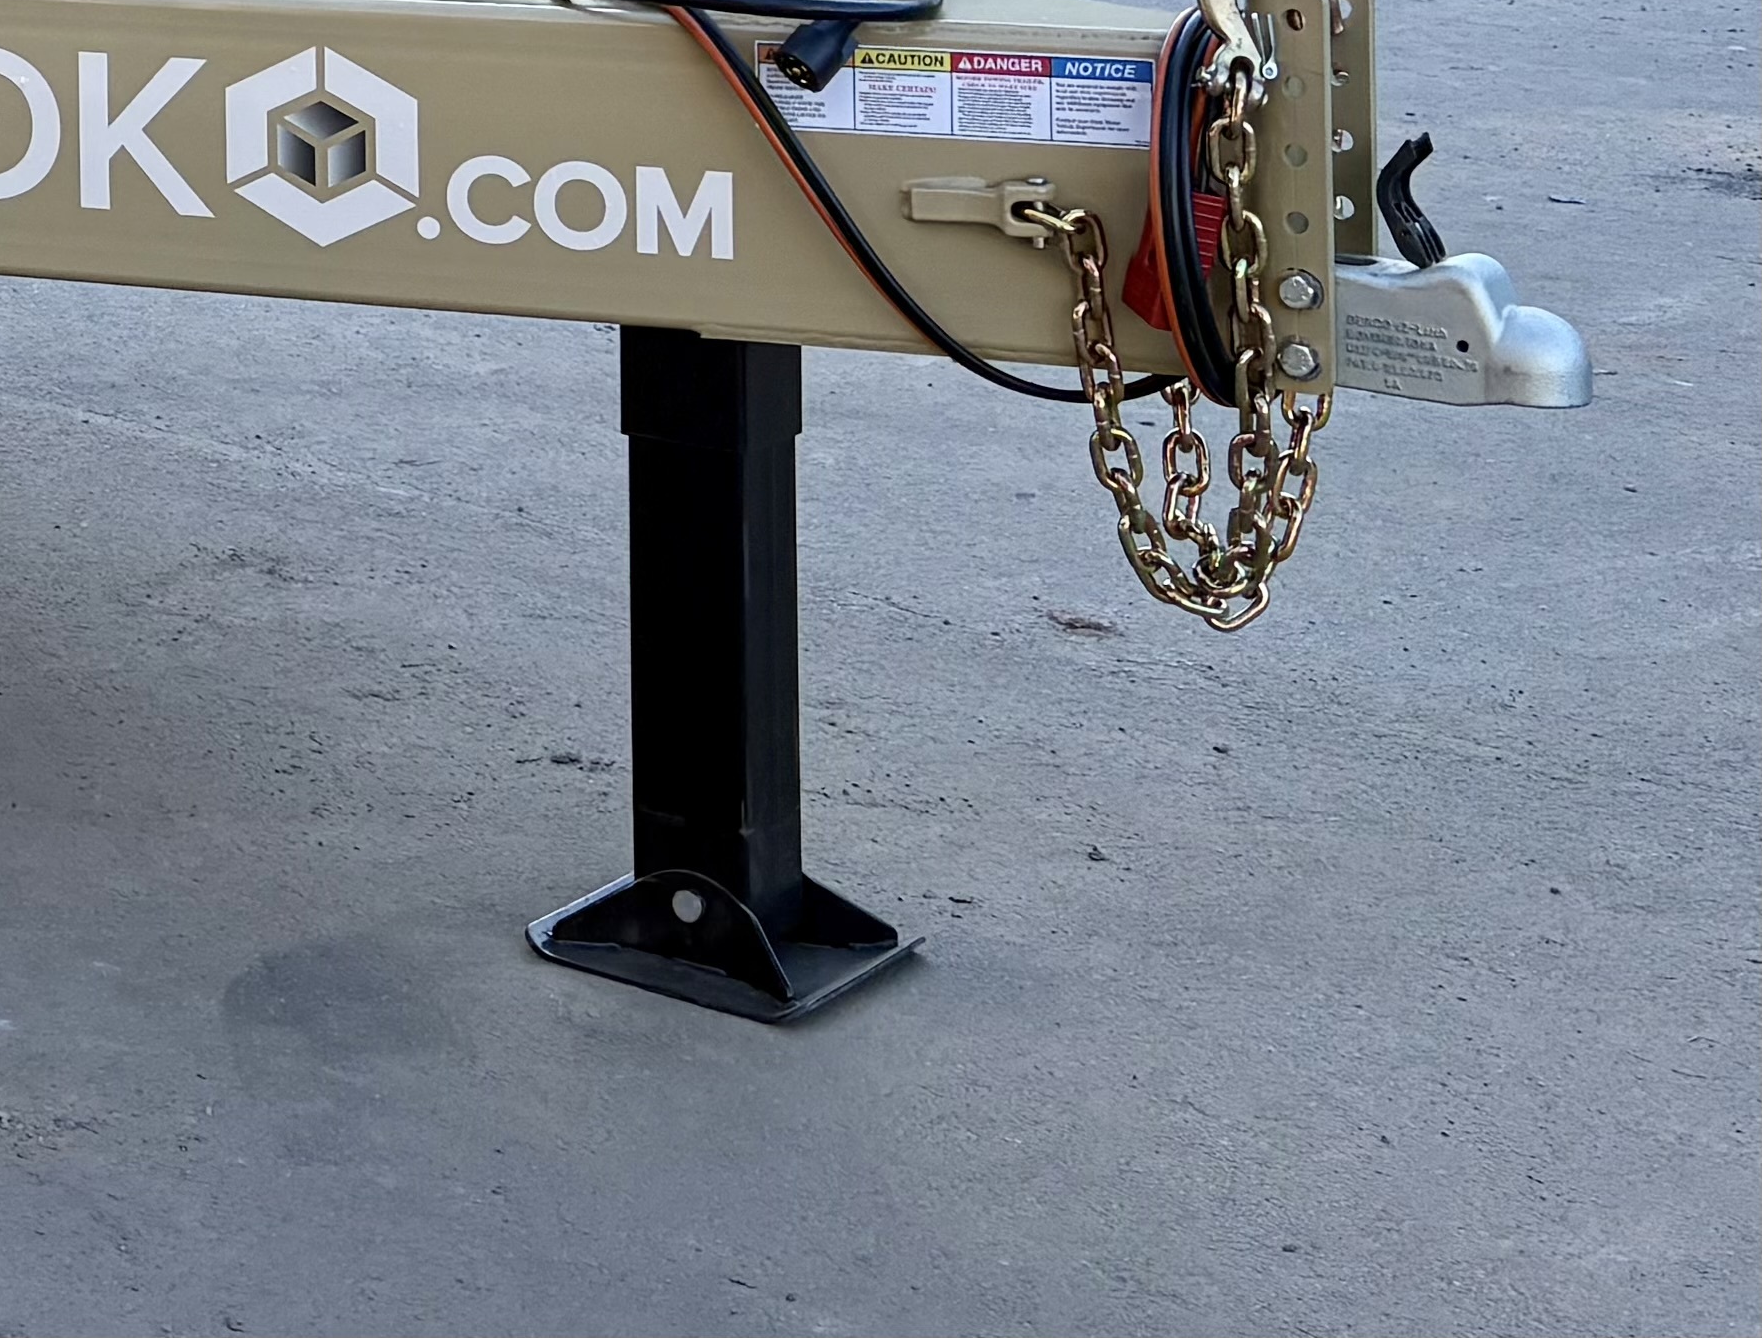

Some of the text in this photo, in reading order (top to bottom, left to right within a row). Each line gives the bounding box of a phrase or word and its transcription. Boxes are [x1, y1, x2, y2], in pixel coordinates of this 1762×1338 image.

[875, 53, 944, 67] CAUTION
[973, 56, 1043, 73] DANGER
[1065, 61, 1137, 78] NOTICE
